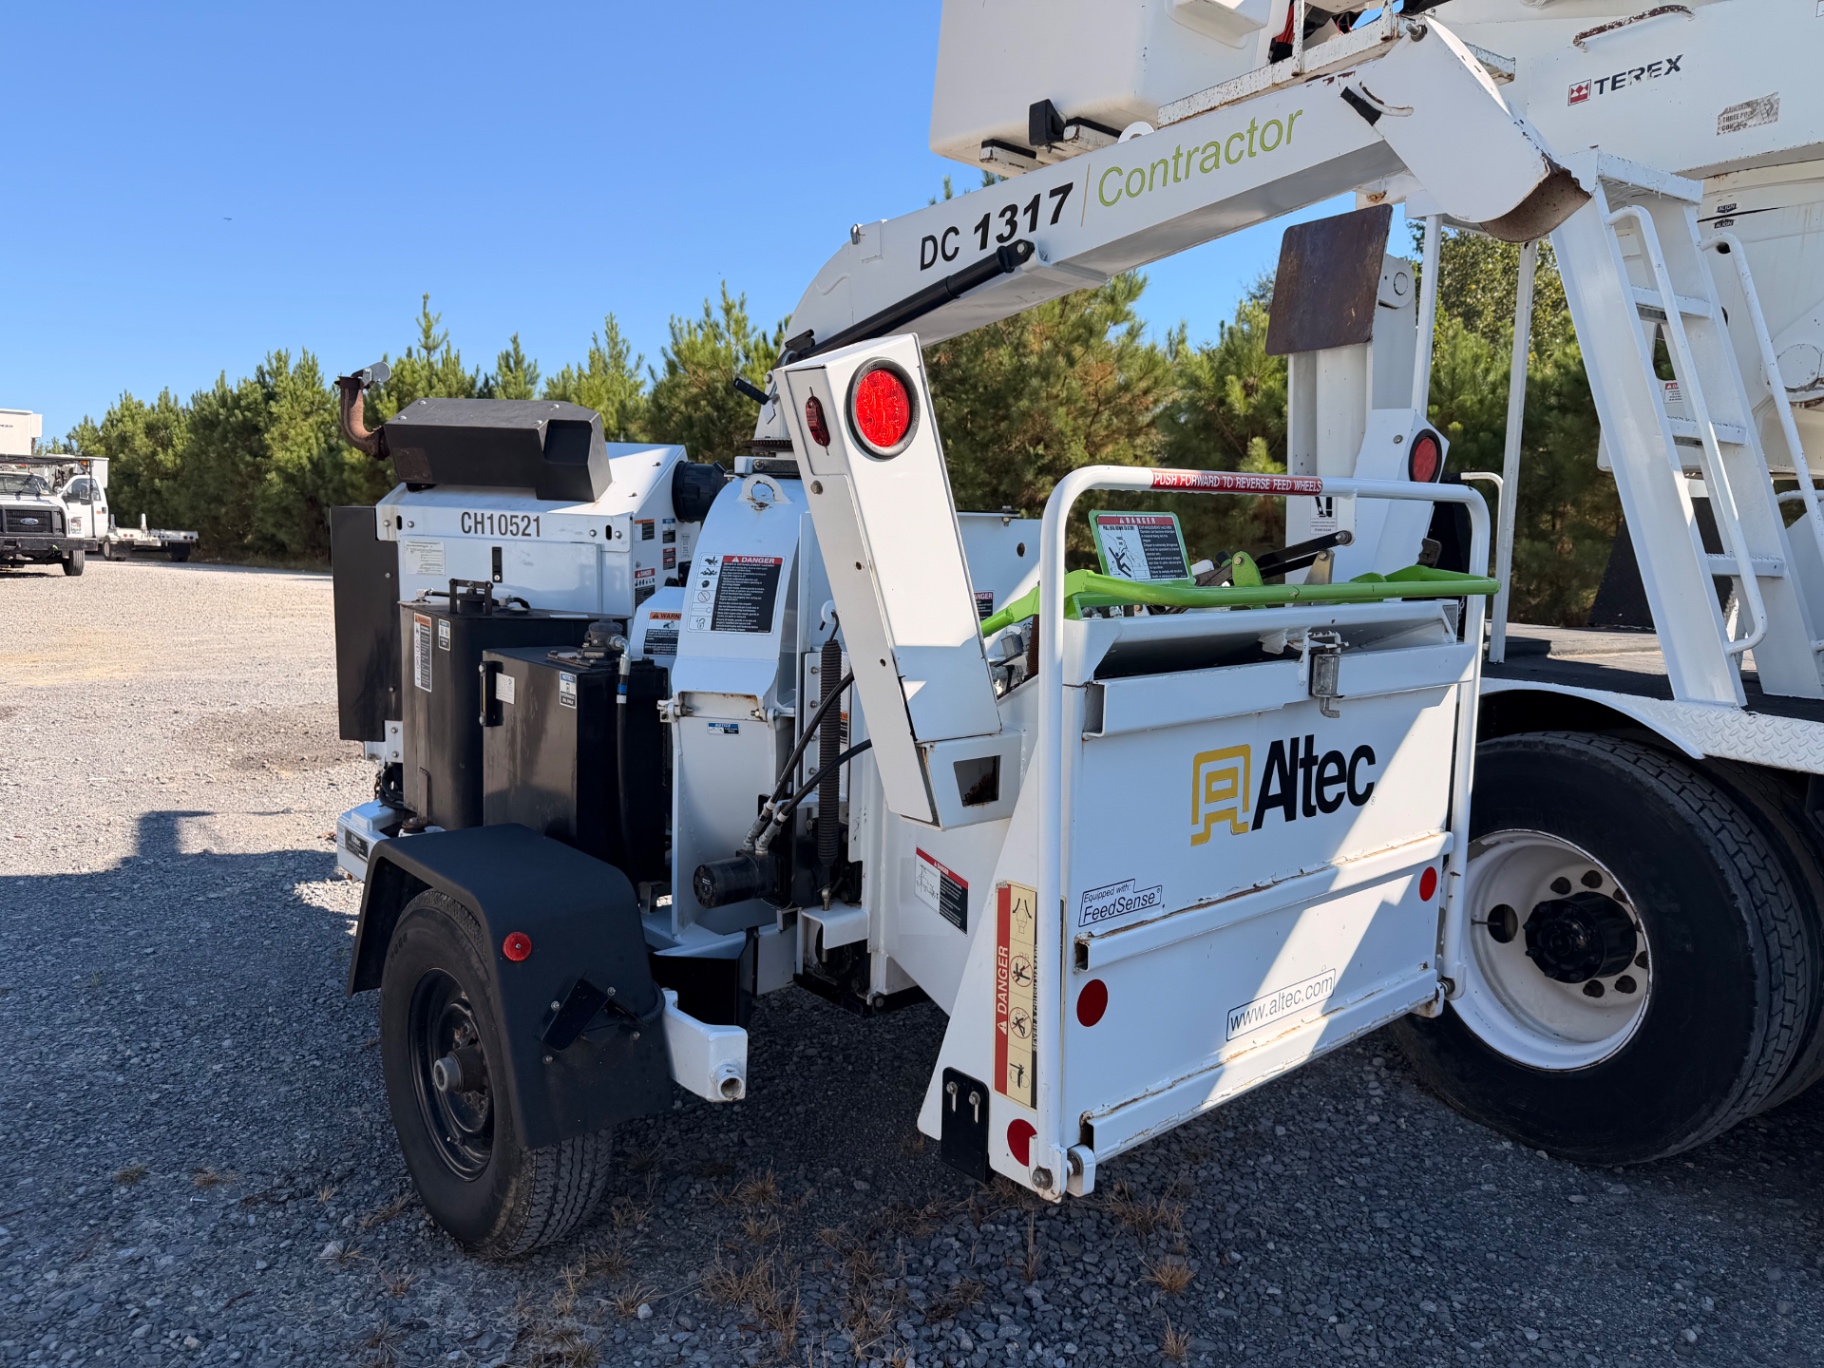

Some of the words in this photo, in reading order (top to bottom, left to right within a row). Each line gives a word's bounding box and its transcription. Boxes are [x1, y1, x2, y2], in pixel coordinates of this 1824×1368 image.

[1593, 54, 1684, 96] TEREX
[1098, 109, 1304, 208] Contractor
[920, 226, 960, 272] DC
[973, 182, 1074, 252] 1317
[1153, 472, 1177, 486] PUSH
[1179, 474, 1220, 487] FORWARD
[1222, 476, 1234, 488] TO
[1235, 477, 1270, 490] REVERSE
[1272, 478, 1292, 491] FEED
[1293, 479, 1322, 492] WHEELS
[461, 511, 541, 538] CH10521
[660, 612, 681, 620] WARN
[1251, 734, 1376, 831] Altec
[1084, 887, 1115, 903] Equipped
[997, 945, 1009, 1015] DANGER
[1230, 976, 1333, 1032] www.altec.com
